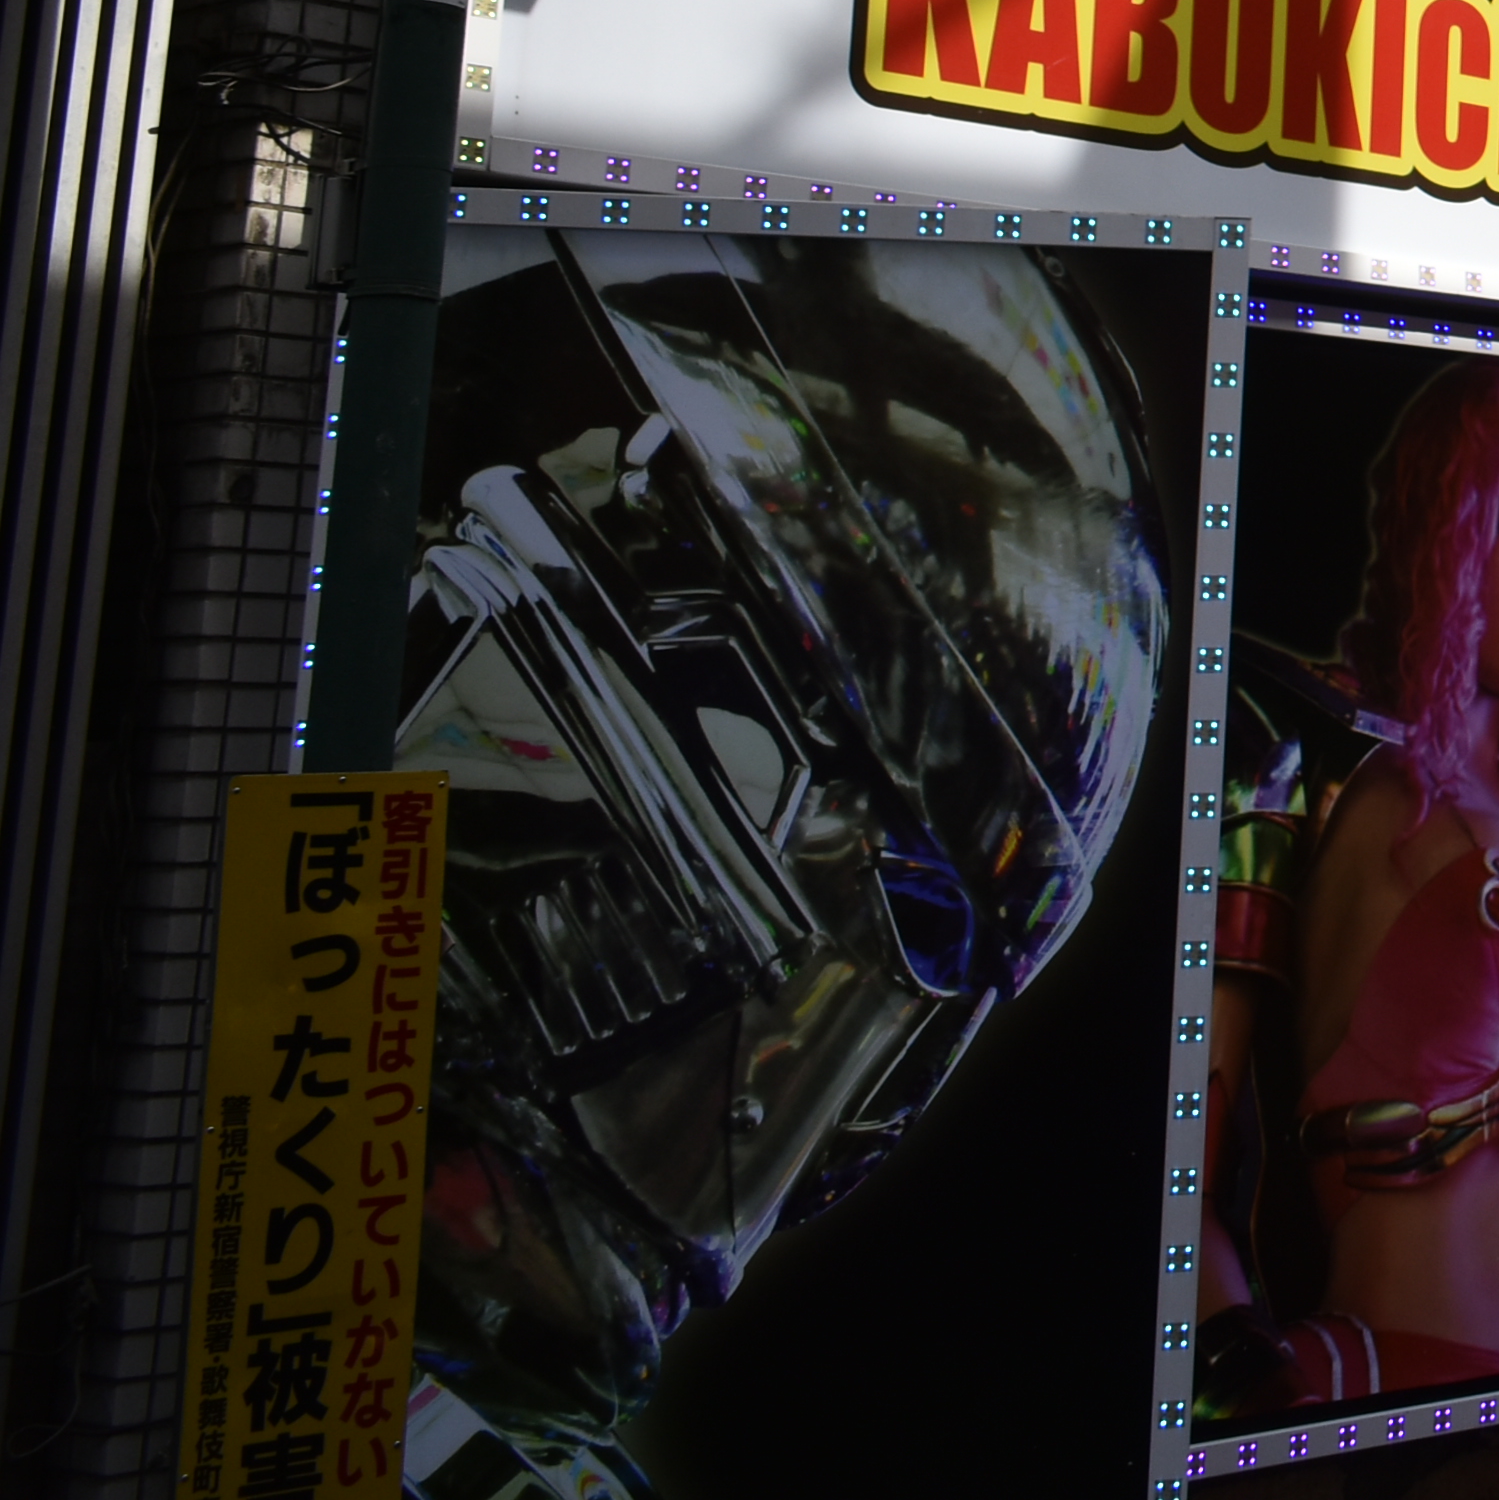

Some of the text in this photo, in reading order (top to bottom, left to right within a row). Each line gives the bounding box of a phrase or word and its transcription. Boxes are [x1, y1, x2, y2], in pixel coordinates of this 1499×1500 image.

[190, 1094, 250, 1500] 警視庁新宿警察署・歌舞伎町
[337, 790, 434, 1488] 客引きにはついていかない
